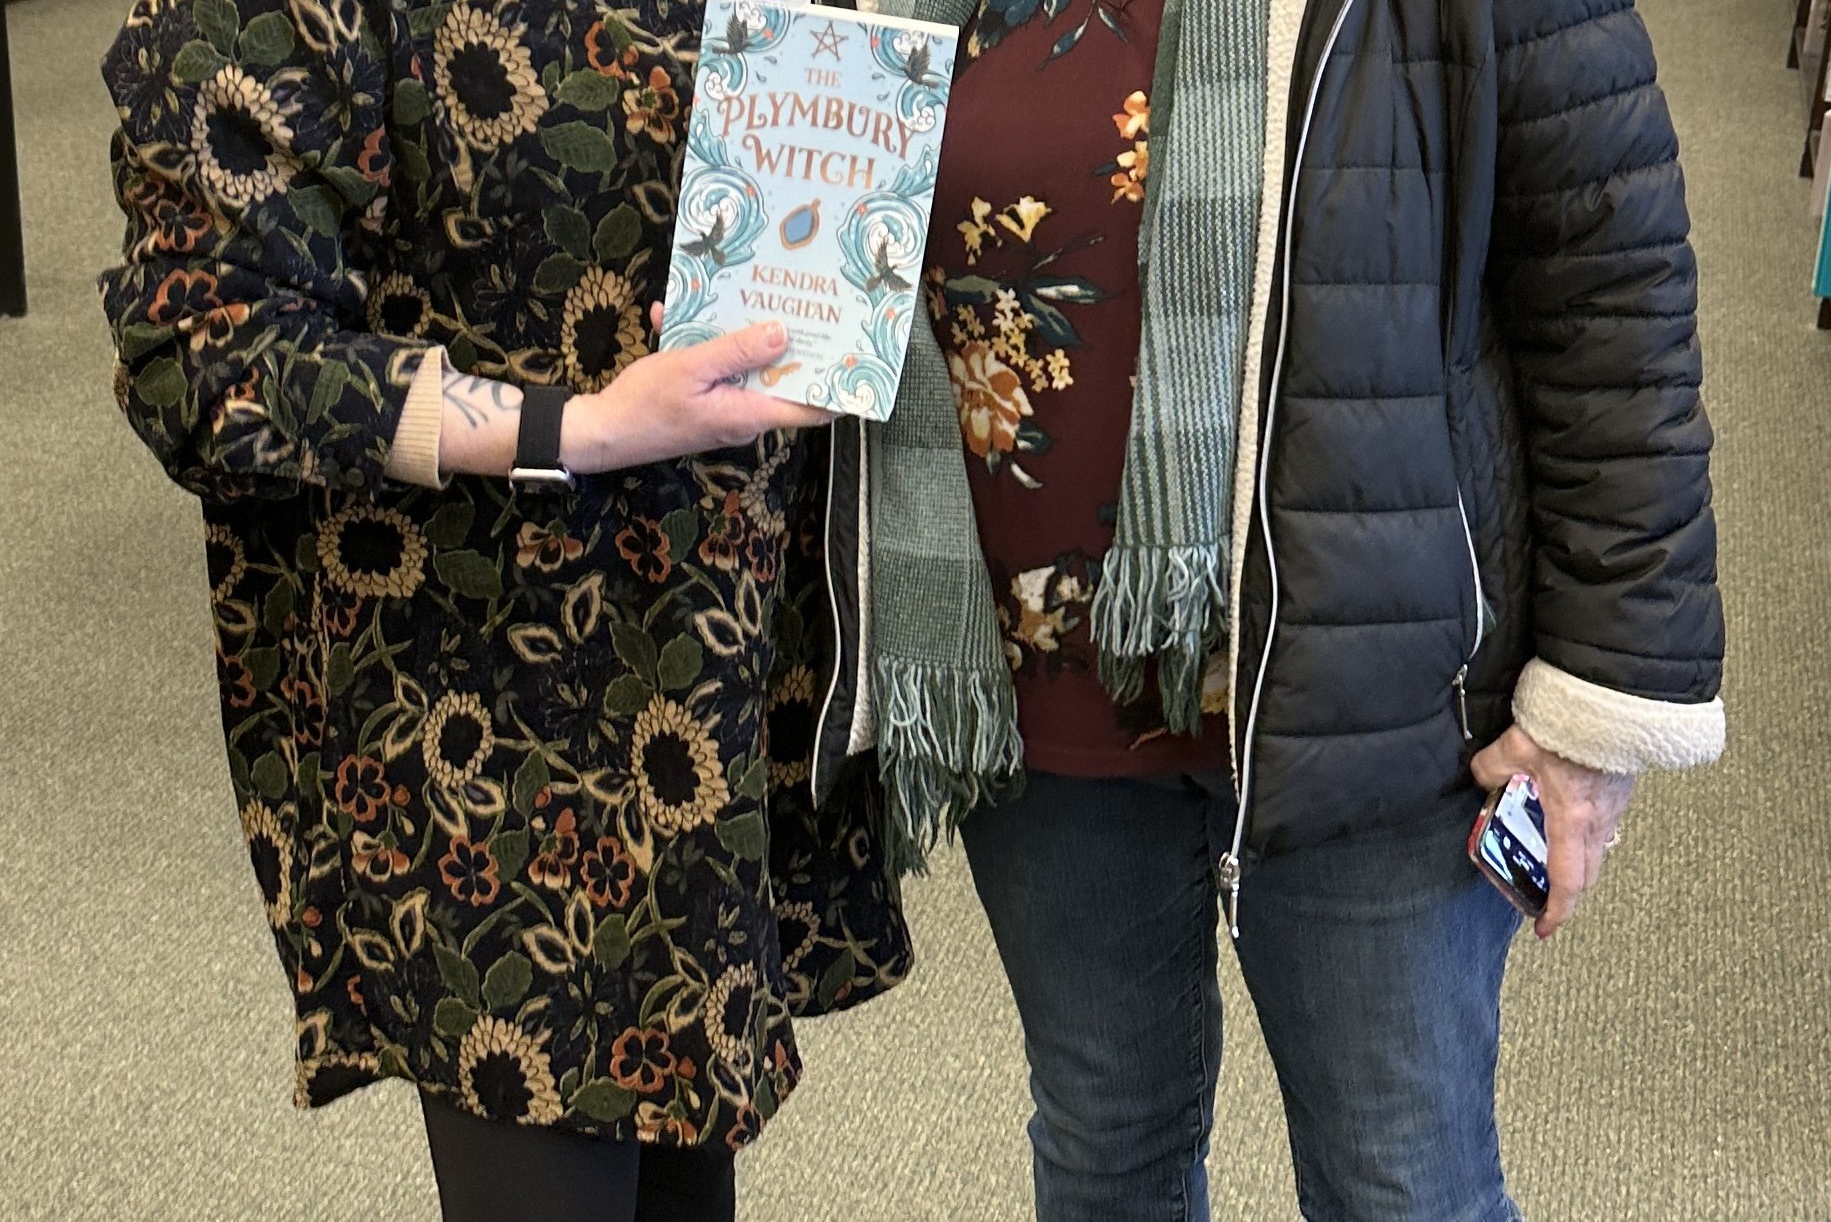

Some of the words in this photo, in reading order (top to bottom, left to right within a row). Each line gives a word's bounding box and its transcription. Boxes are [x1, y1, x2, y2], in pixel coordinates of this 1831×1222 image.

[804, 67, 842, 88] THE
[716, 90, 917, 161] PLYMBURY
[741, 132, 876, 190] WITCH
[751, 264, 839, 297] KENDRA
[739, 287, 842, 325] VAUGHAN
